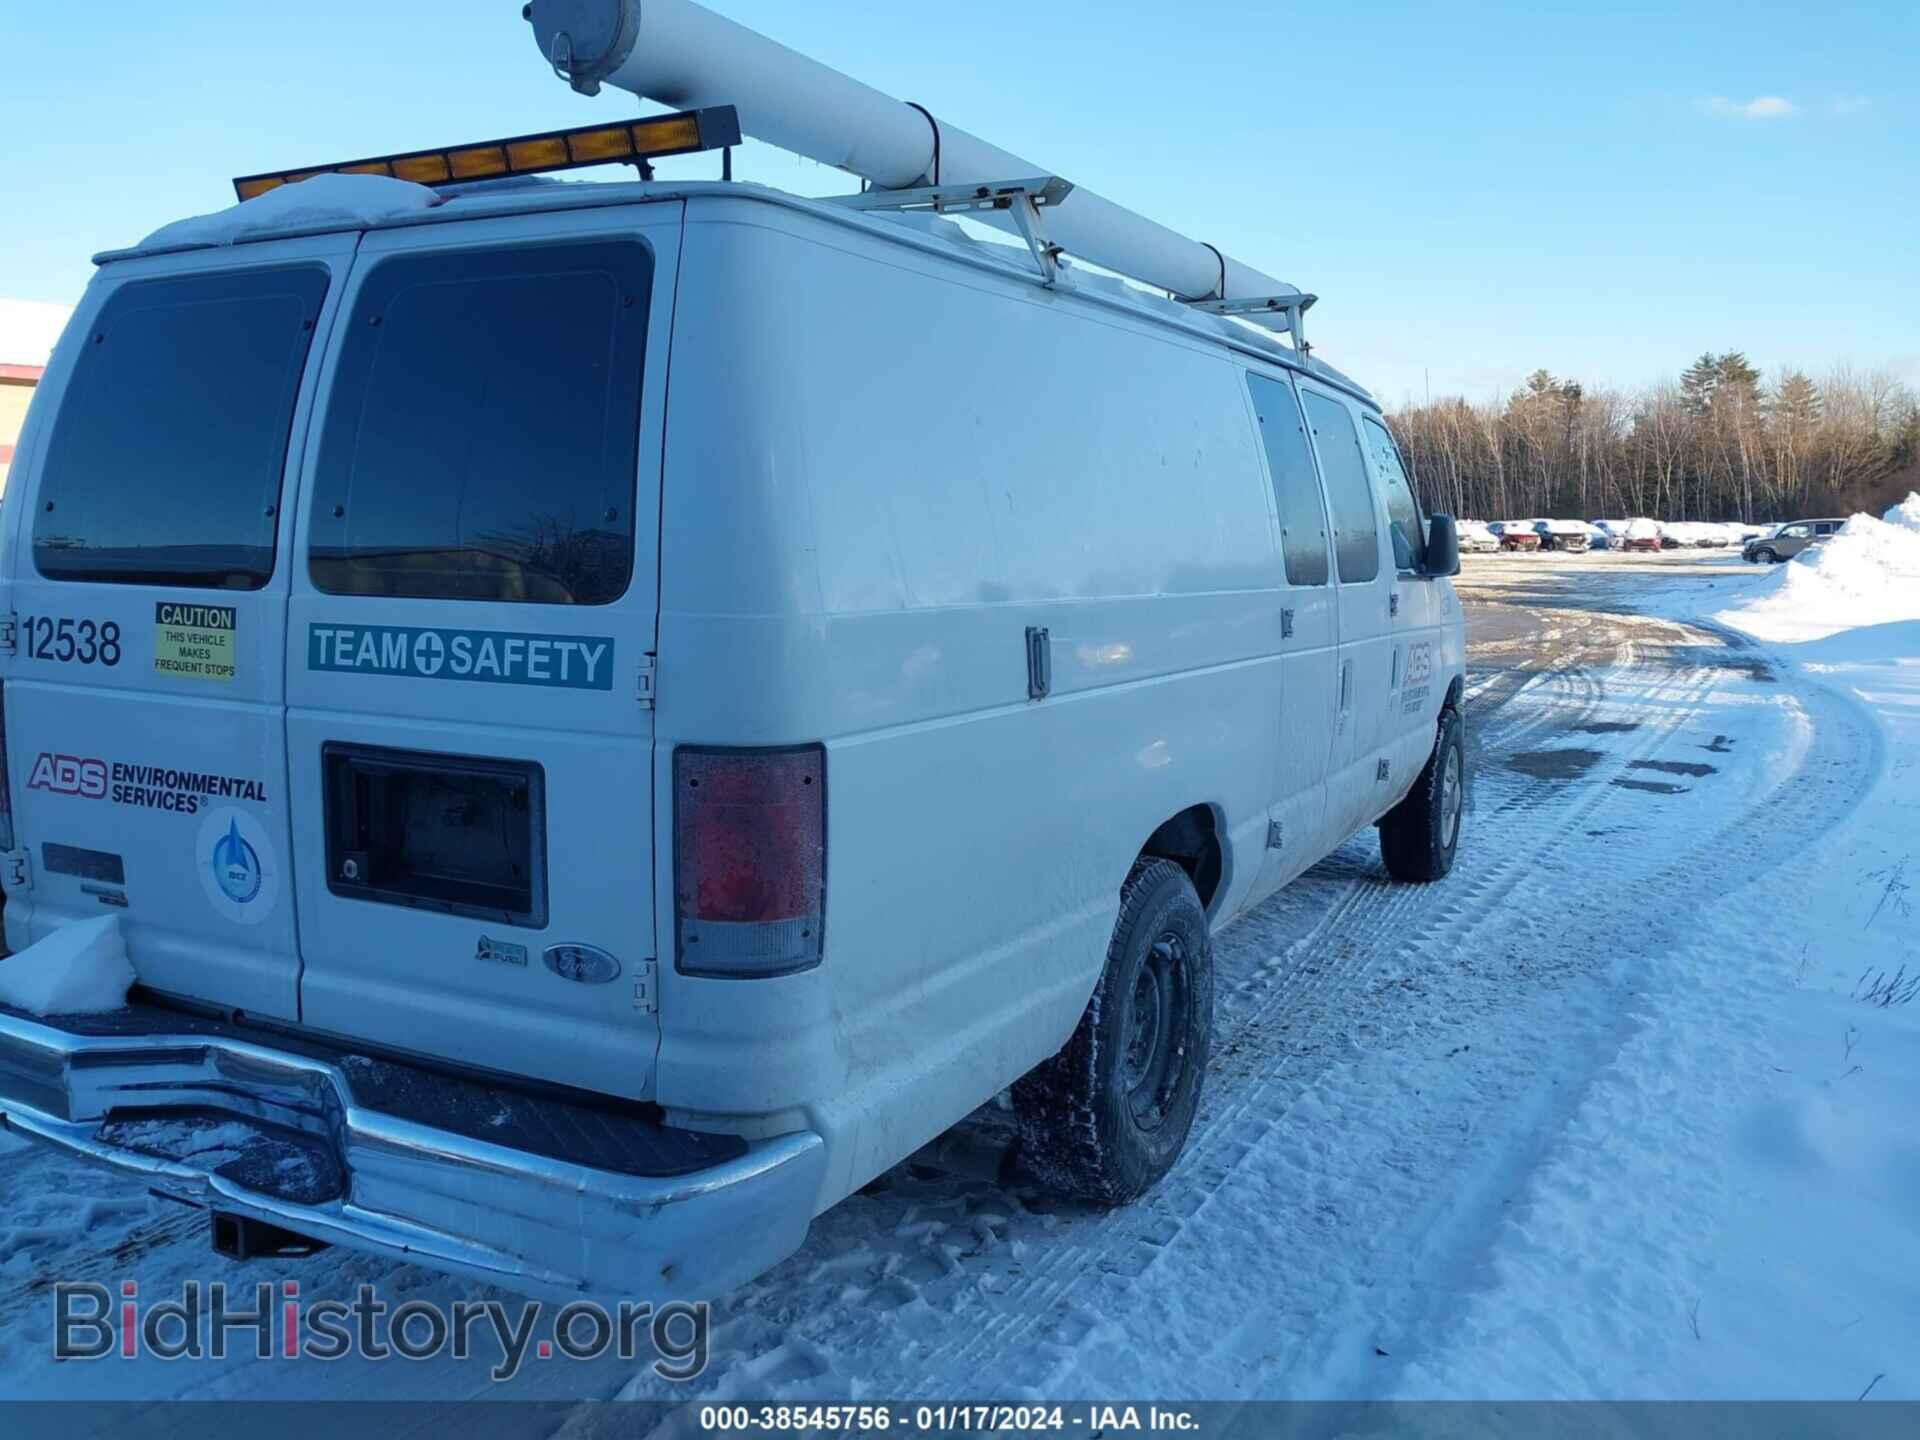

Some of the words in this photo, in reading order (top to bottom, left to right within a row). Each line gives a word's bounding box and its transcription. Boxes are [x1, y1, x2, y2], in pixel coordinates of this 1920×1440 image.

[159, 604, 232, 629] CAUTION
[22, 615, 121, 666] 12538
[165, 630, 186, 644] THIS
[187, 632, 225, 648] VEHICLE
[178, 646, 211, 660] MAKES
[154, 658, 202, 675] FREQUENT
[204, 662, 235, 677] STOPS
[313, 629, 408, 669] TEAM
[450, 636, 606, 683] SAFETY
[26, 752, 108, 800] ADS
[112, 762, 268, 802] ENVIRONMENTAL
